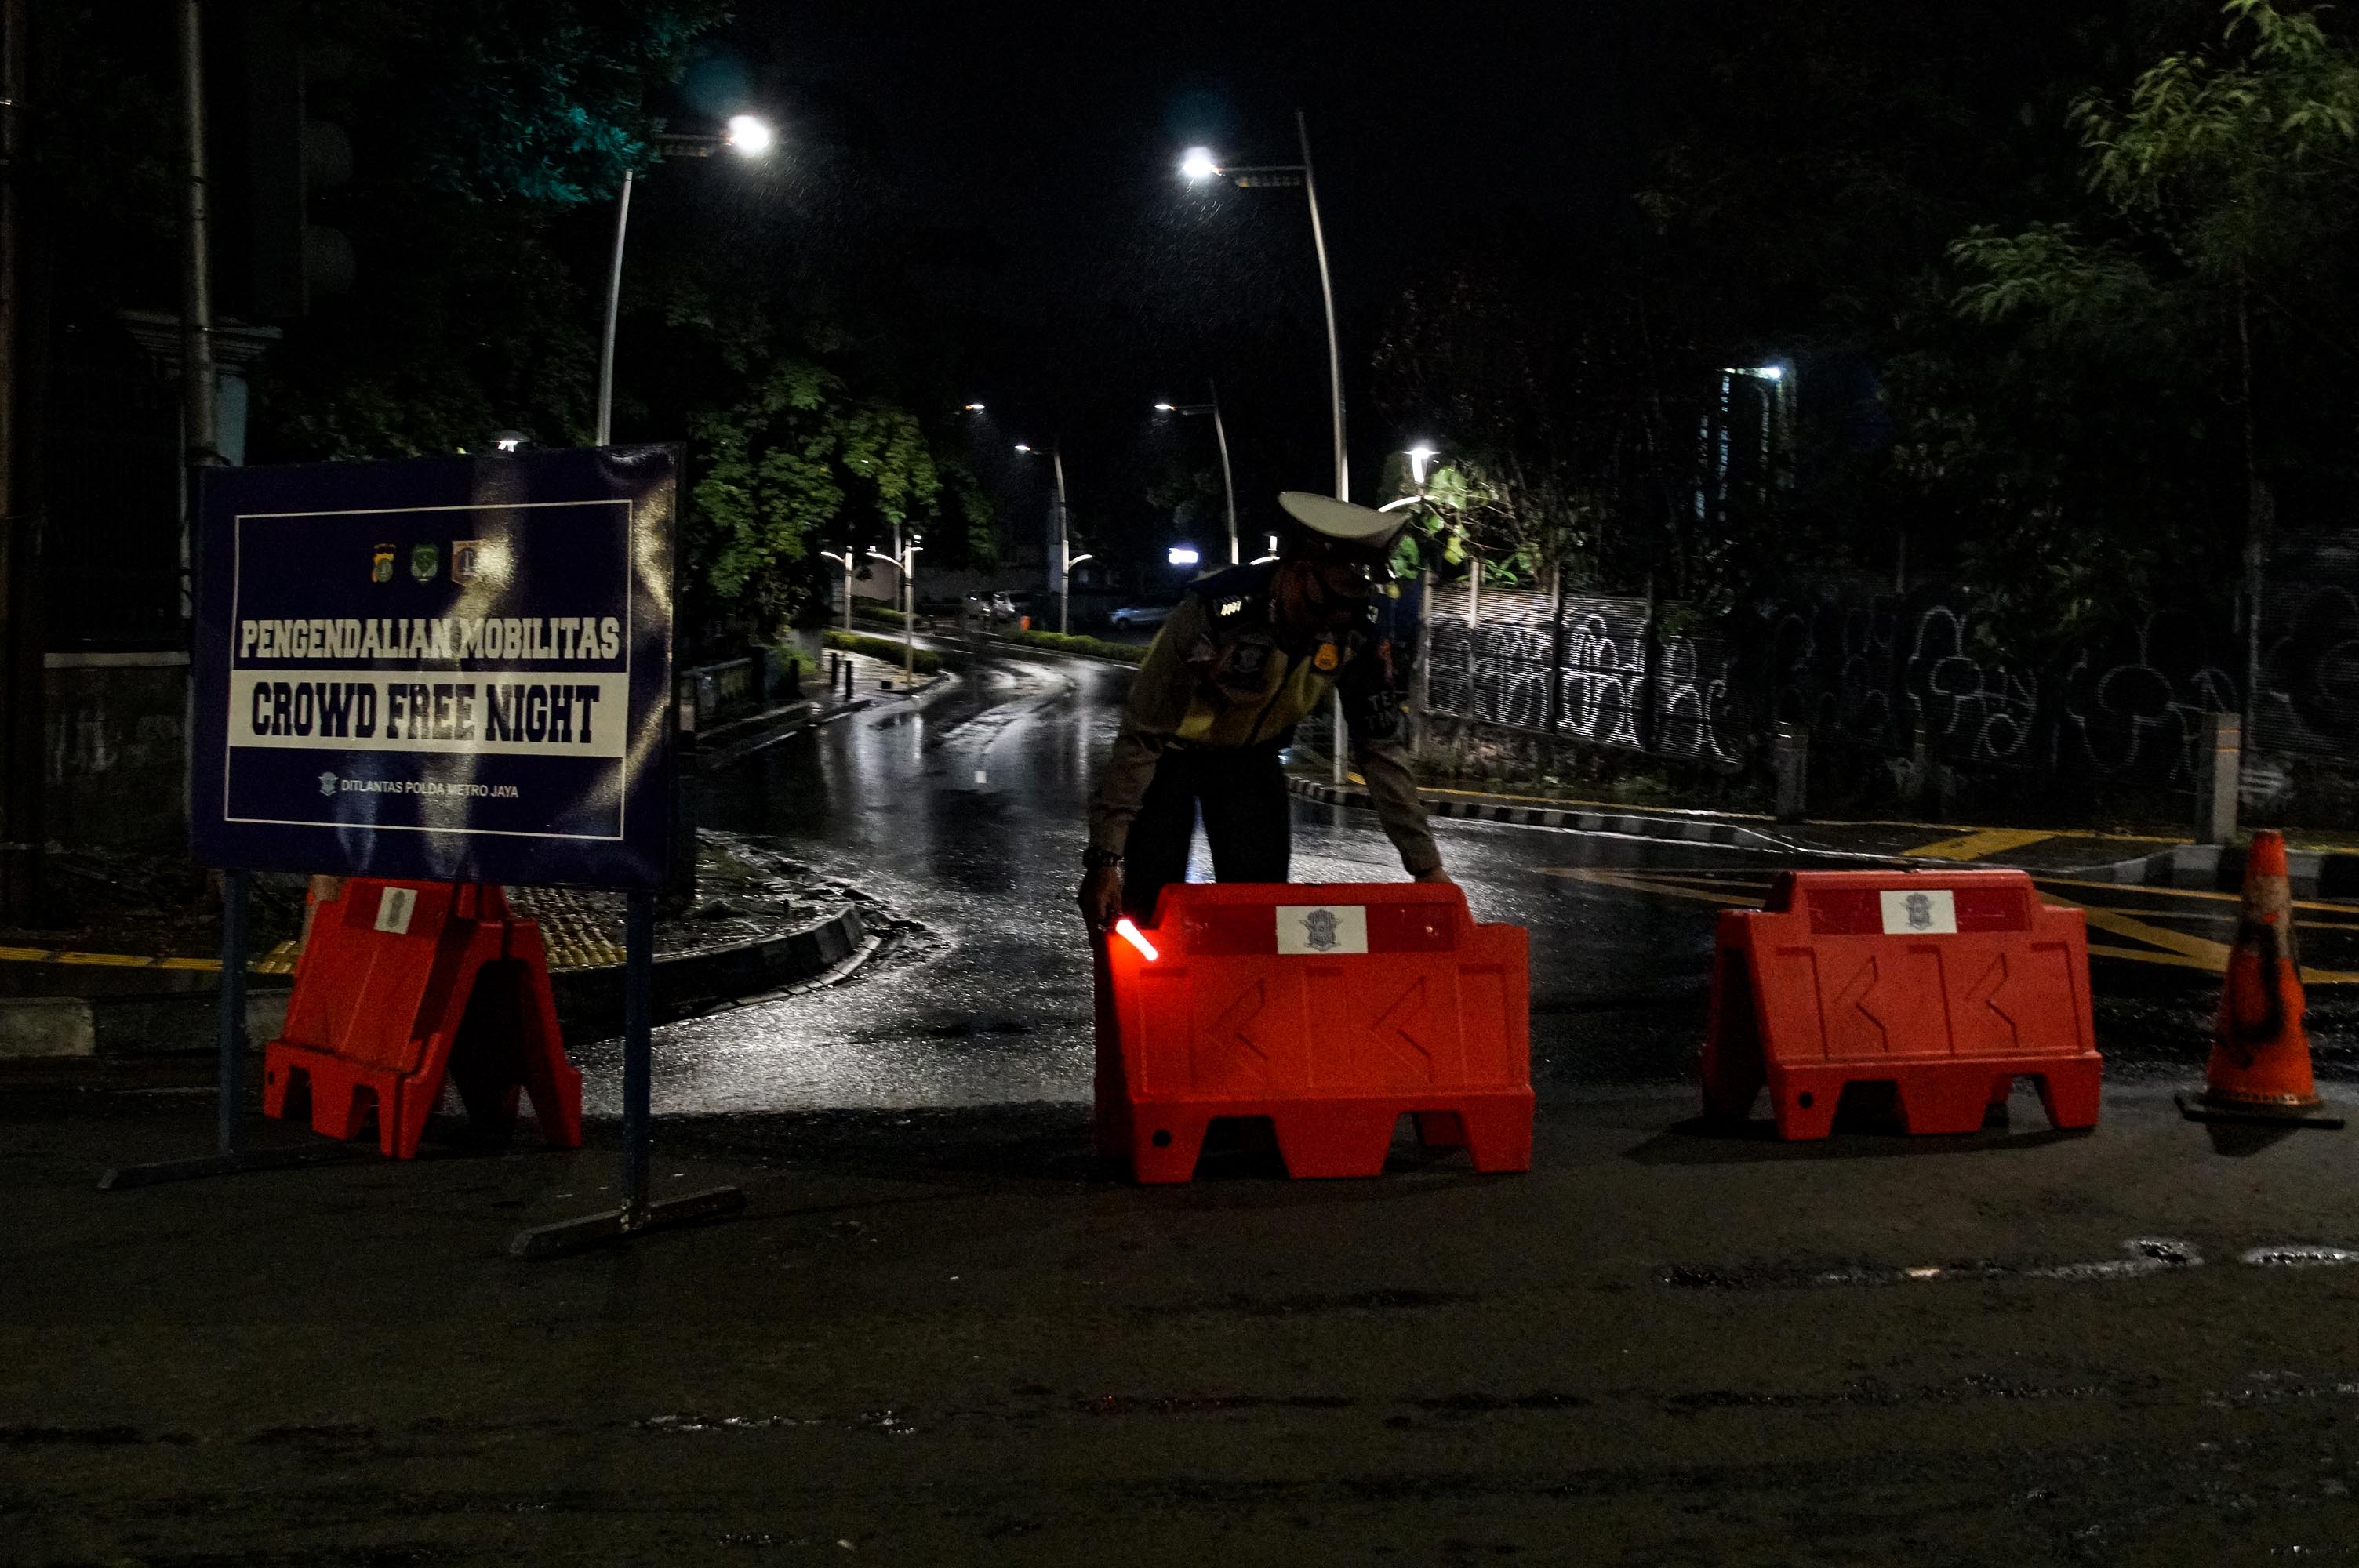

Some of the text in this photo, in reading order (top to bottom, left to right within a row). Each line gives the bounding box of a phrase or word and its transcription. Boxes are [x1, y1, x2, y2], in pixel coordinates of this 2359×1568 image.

[240, 617, 620, 659] PENGENDALIAN MOBILITAS
[252, 681, 601, 743] CROWD FREE NIGHT
[341, 779, 519, 798] DITLANTAS POLDA METRO JAYA
